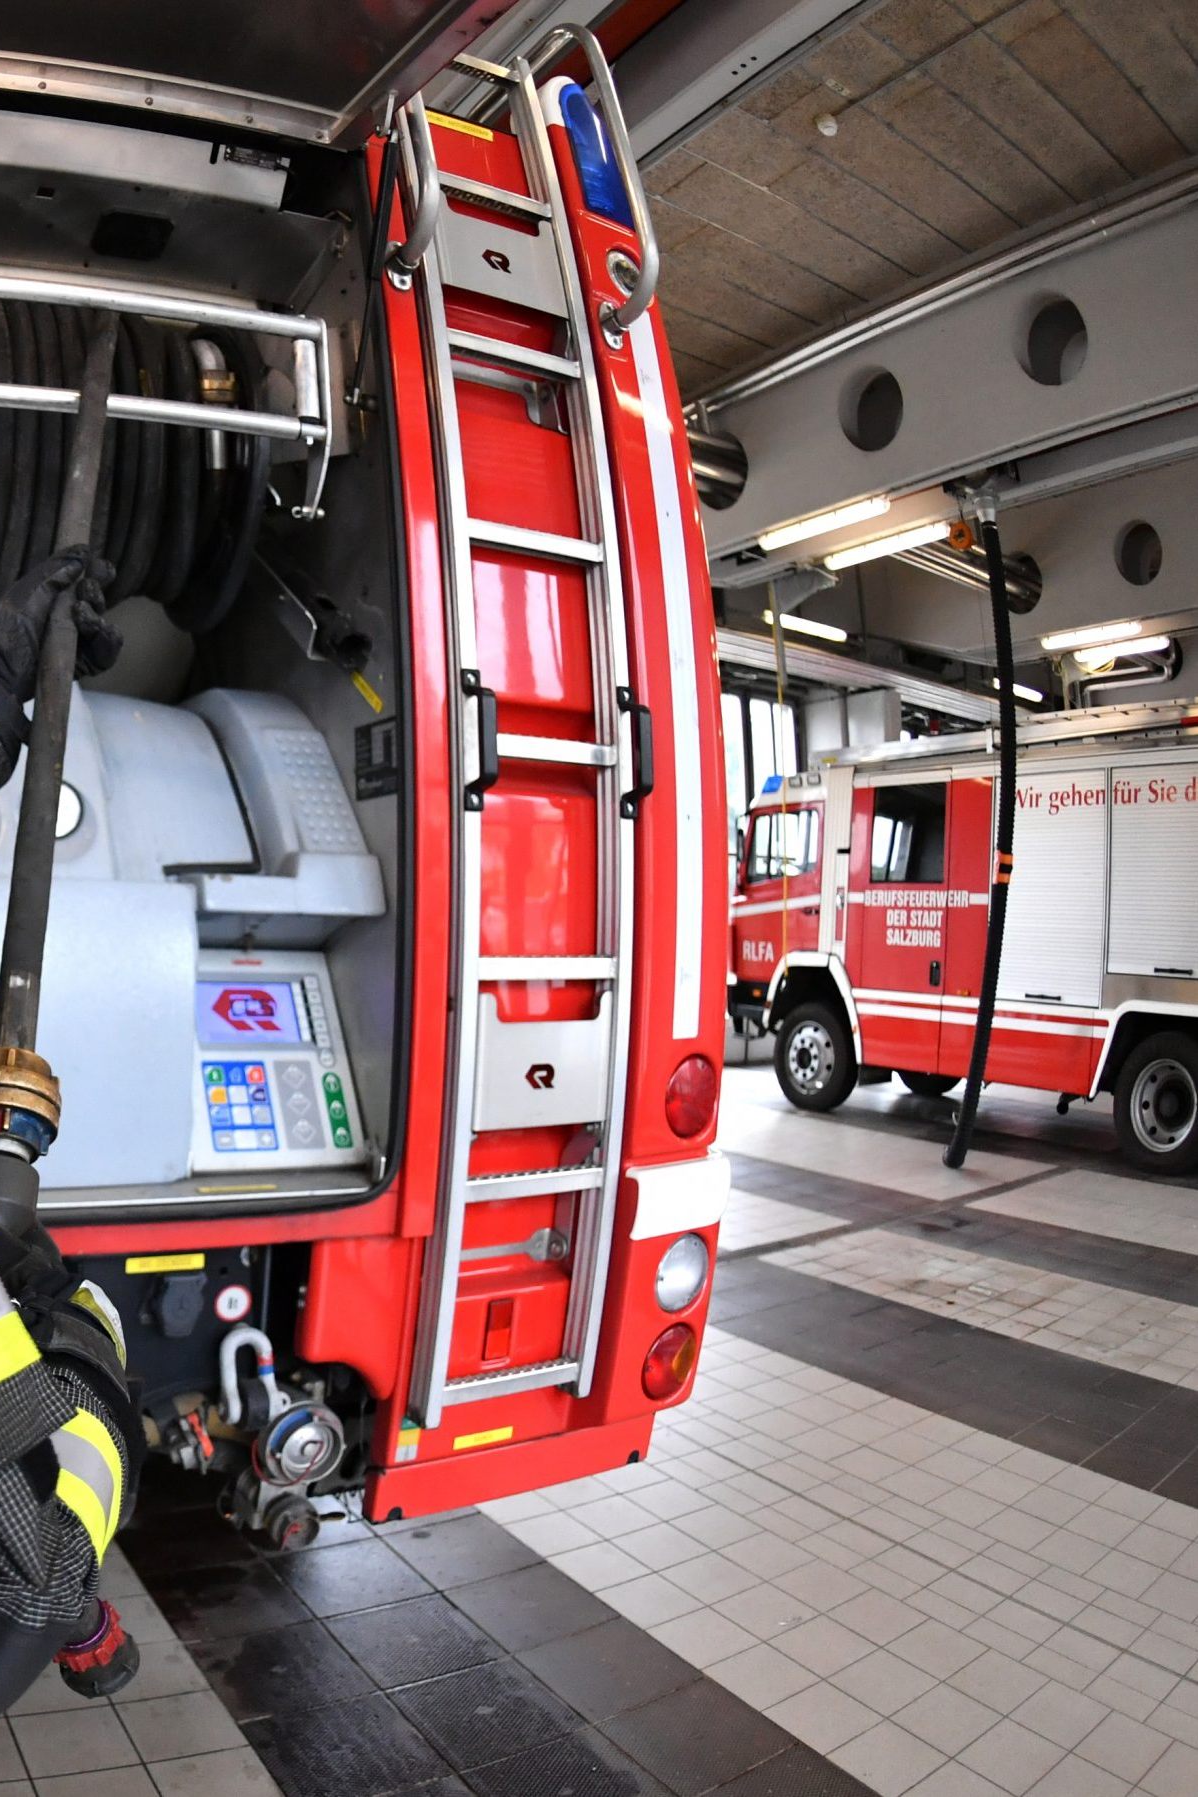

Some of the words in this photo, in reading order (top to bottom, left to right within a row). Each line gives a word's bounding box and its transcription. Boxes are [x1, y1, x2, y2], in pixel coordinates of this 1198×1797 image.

[1048, 783, 1106, 816] gehen
[1112, 780, 1141, 805] für
[1148, 779, 1177, 803] Sie
[865, 889, 969, 908] BERUFSFEUERWEHR
[886, 910, 908, 928] DER
[910, 910, 943, 928] STADT
[886, 928, 941, 947] SALZBURG
[742, 940, 774, 962] RLFA
